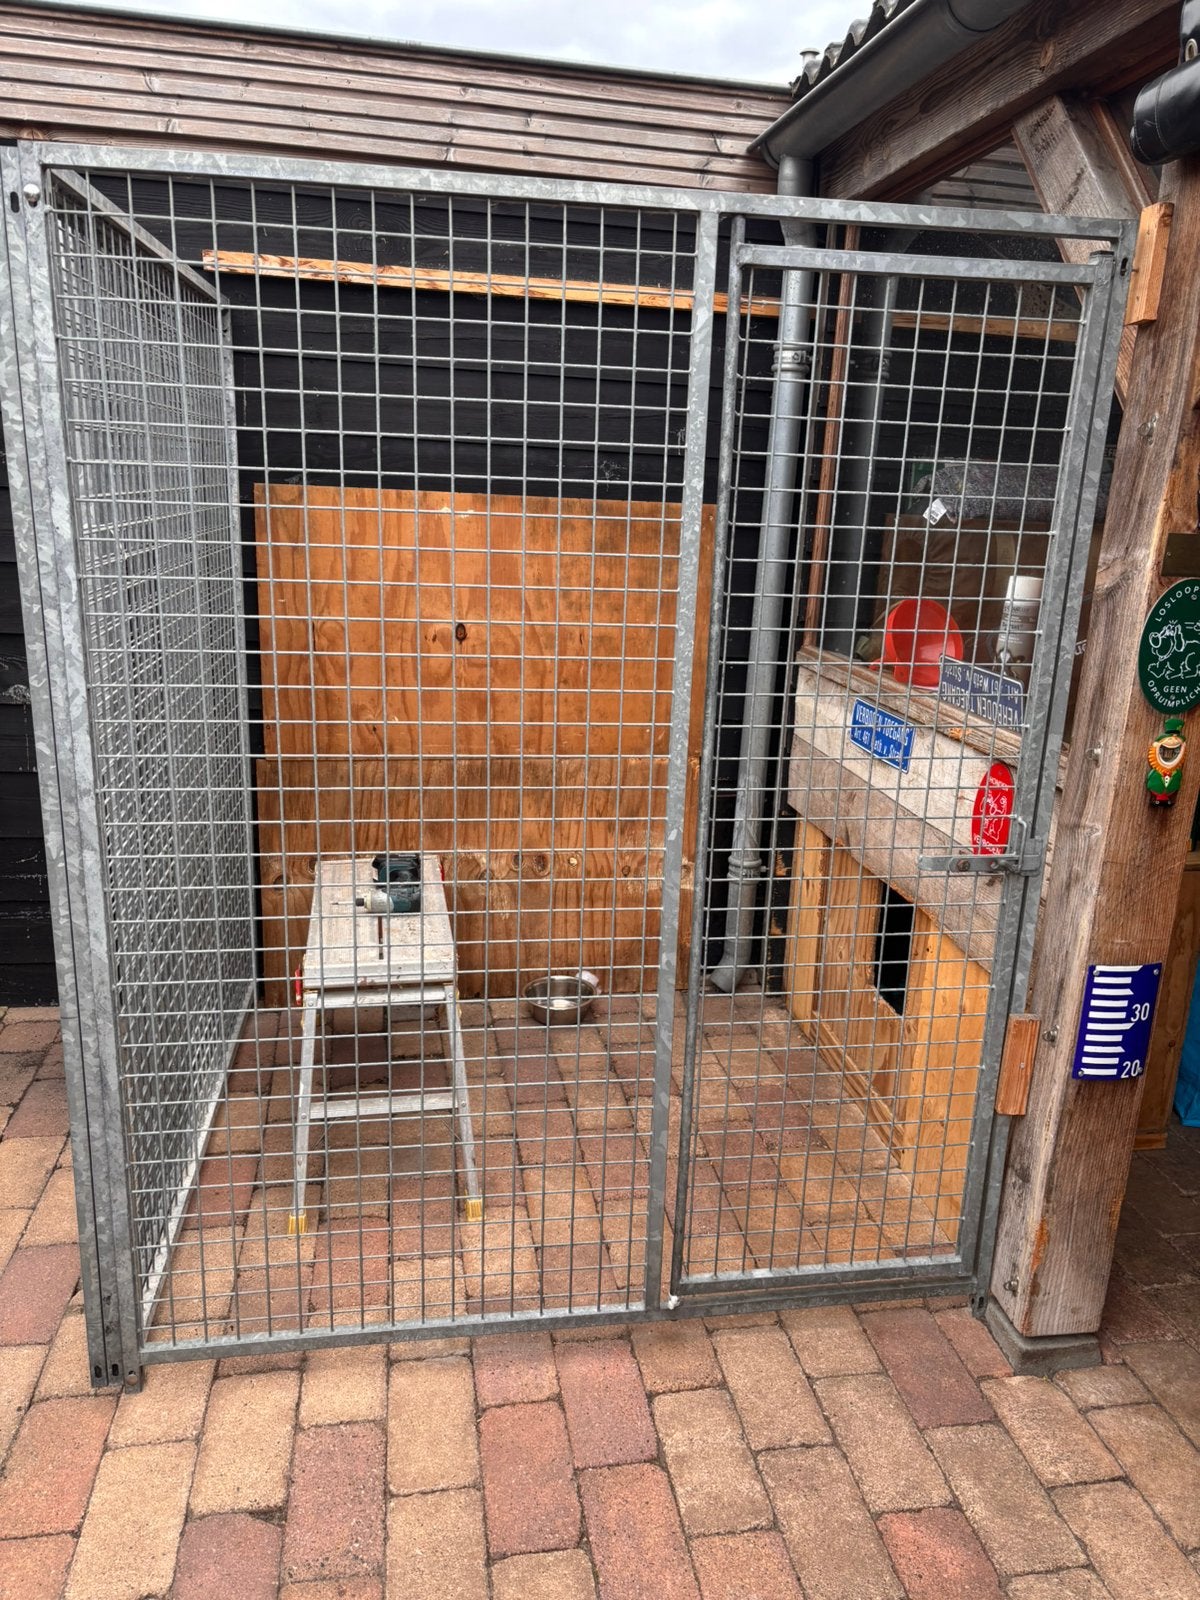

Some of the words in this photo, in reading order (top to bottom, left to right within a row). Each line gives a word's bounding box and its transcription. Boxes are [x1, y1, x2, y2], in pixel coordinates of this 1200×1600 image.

[1155, 586, 1199, 621] LOSLOOP
[1148, 681, 1200, 707] OPRUIMPLICH
[1163, 685, 1187, 693] GEEN
[1131, 1002, 1150, 1022] 30
[1120, 1059, 1140, 1078] 20
